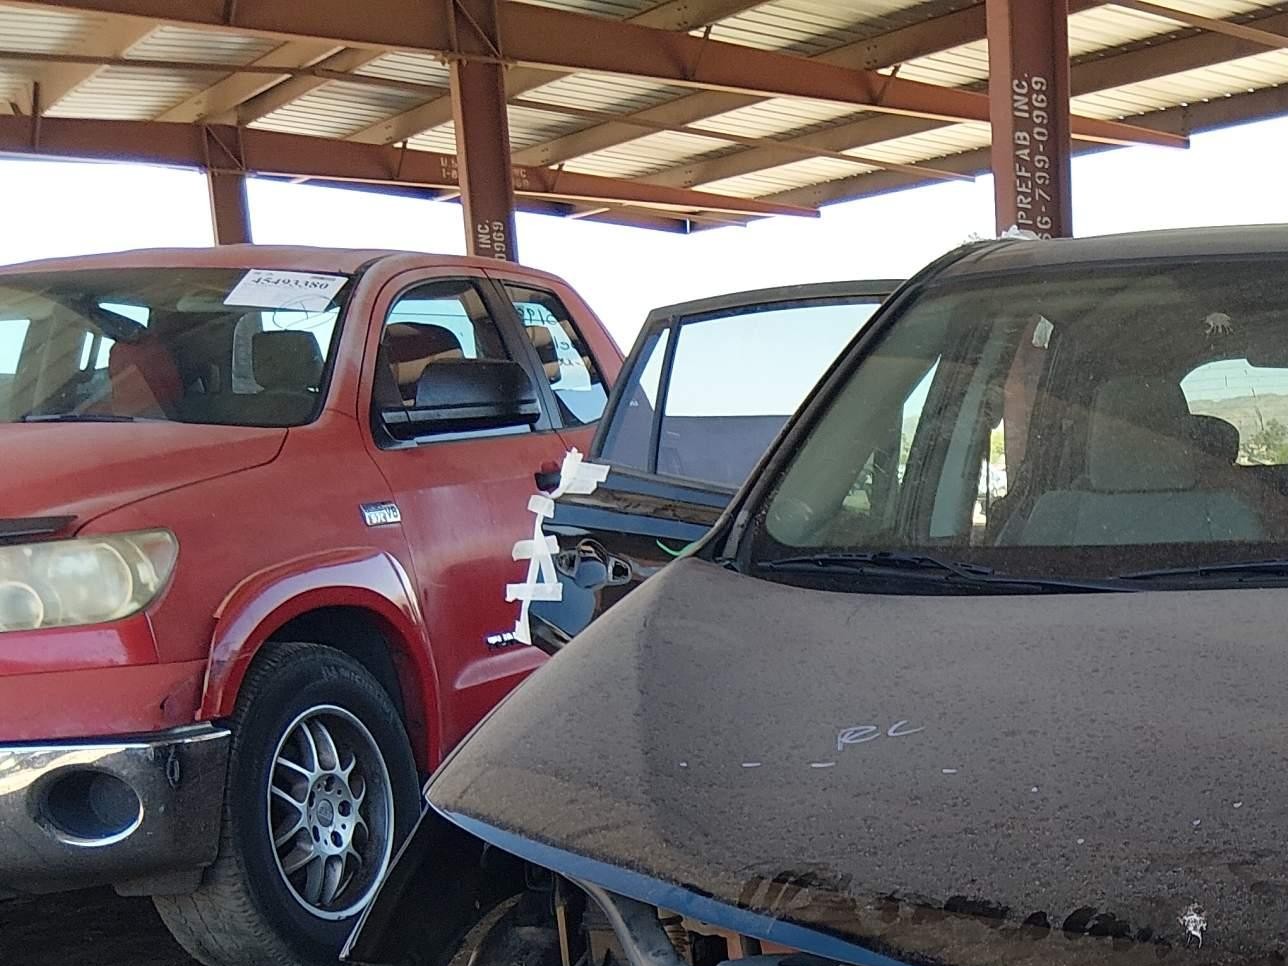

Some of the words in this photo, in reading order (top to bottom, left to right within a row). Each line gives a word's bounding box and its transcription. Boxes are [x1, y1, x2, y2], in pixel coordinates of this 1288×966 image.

[1012, 73, 1030, 118] INC.
[1014, 130, 1033, 225] PREFAB
[477, 220, 491, 248] INC.
